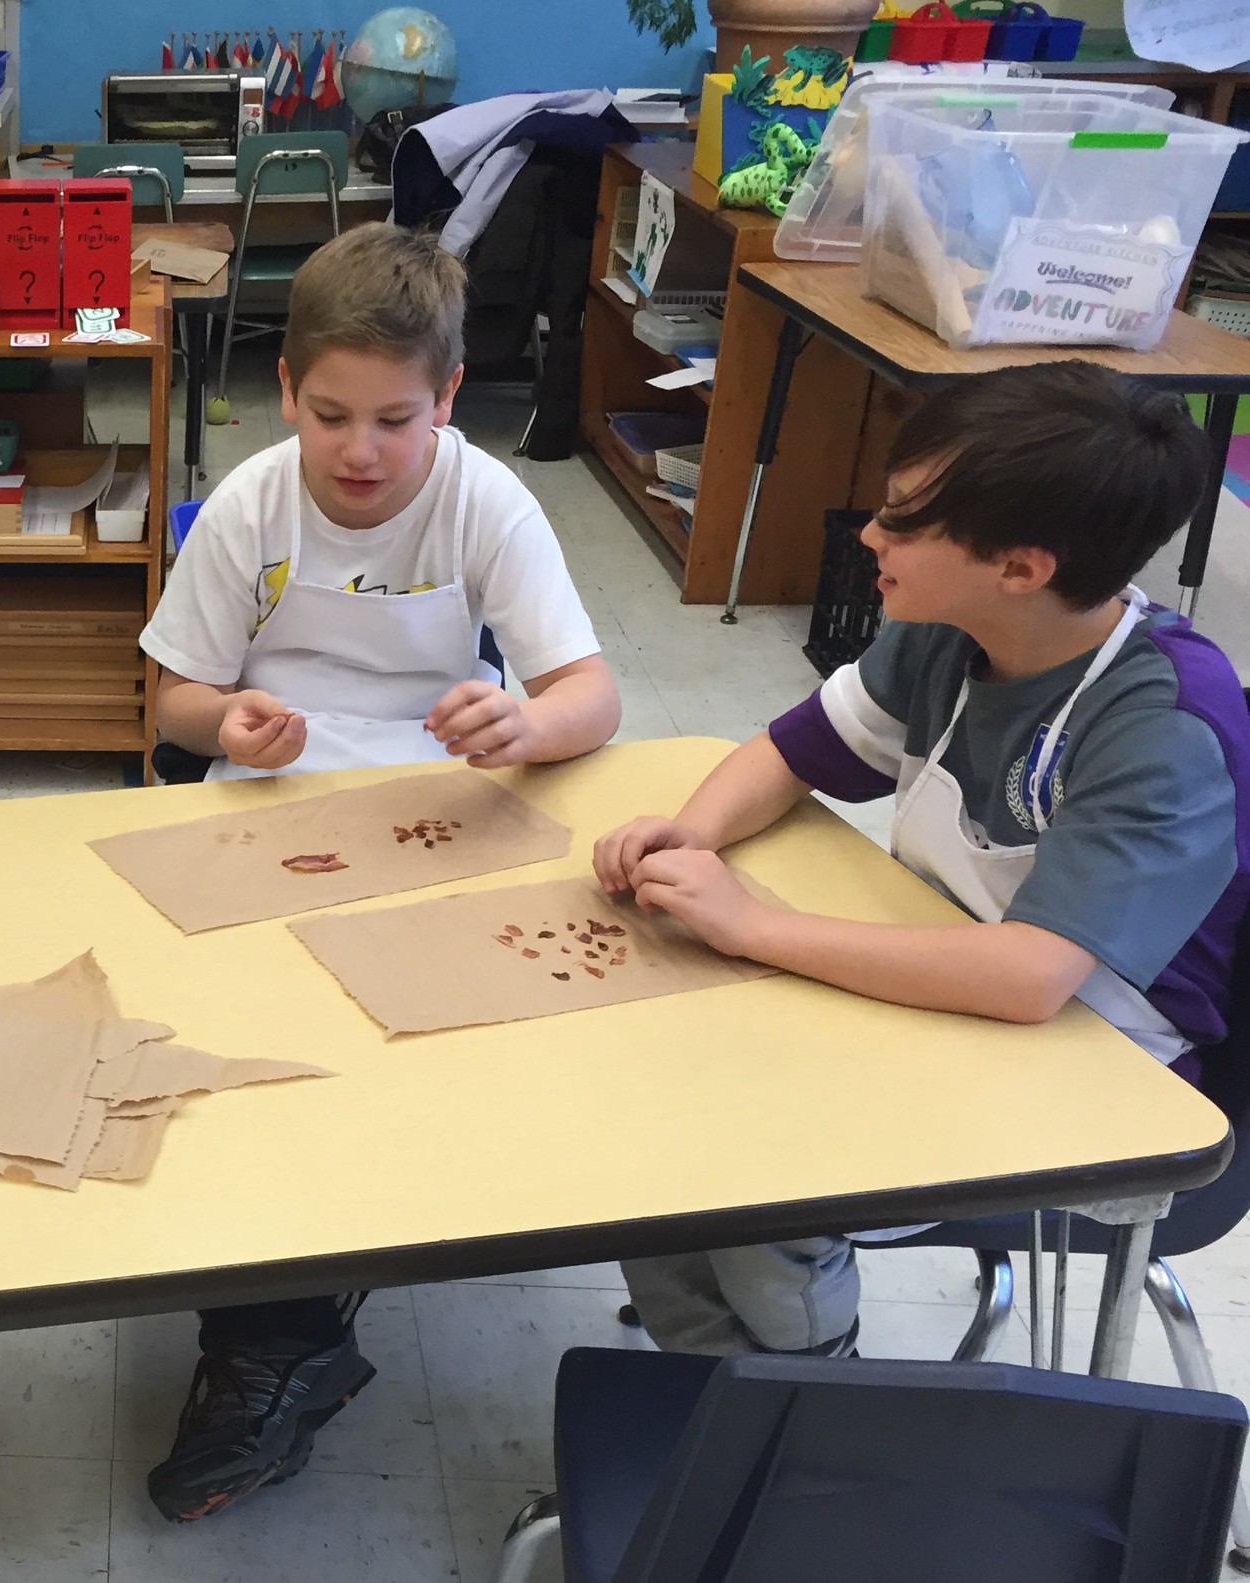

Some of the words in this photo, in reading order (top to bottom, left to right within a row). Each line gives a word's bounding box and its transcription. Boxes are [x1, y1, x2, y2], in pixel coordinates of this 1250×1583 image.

[7, 233, 26, 244] Flip
[29, 233, 49, 244] Flop
[77, 233, 96, 244] Flip
[98, 233, 120, 244] Flop
[19, 270, 36, 293] ?
[88, 270, 105, 293] ?
[1037, 261, 1134, 290] Welcome!
[993, 287, 1151, 332] ADVENTURE
